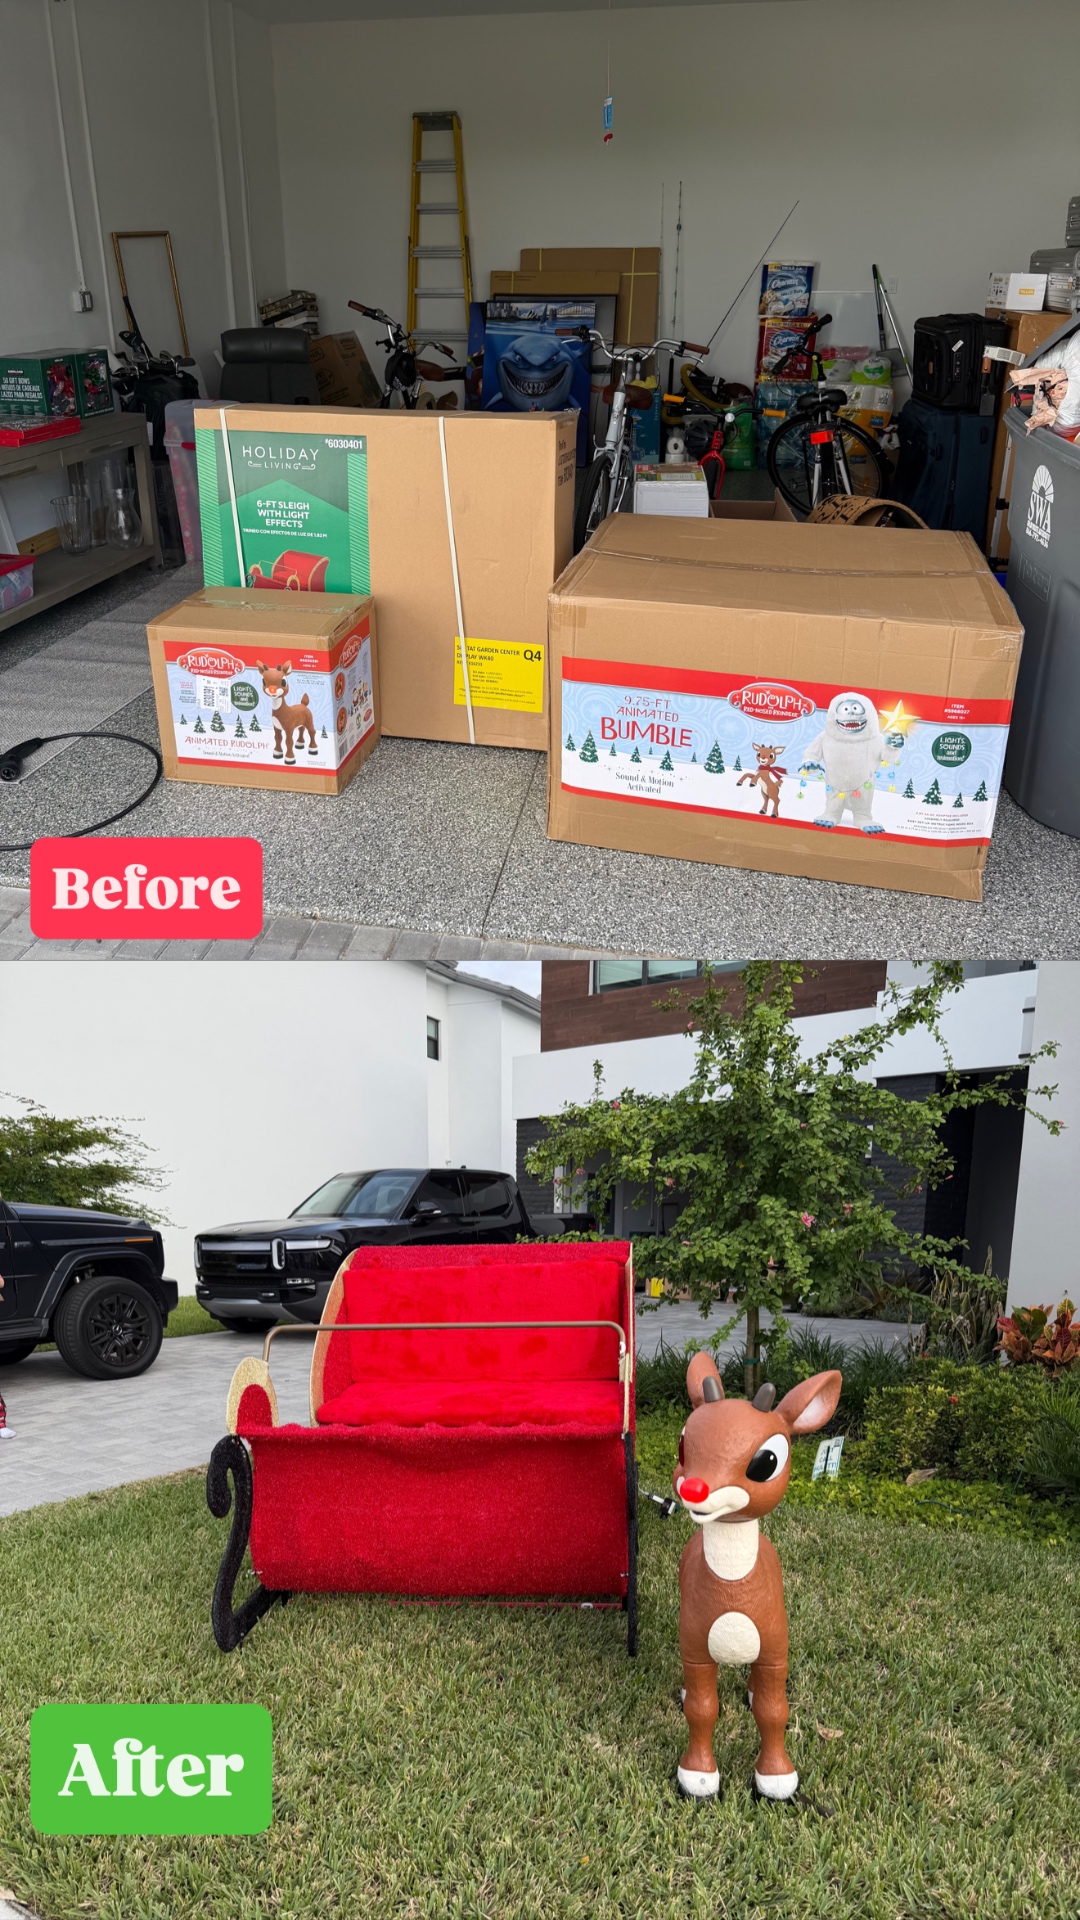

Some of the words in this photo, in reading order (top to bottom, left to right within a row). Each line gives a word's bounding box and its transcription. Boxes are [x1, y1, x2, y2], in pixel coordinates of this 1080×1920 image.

[771, 278, 799, 289] Charmin
[325, 438, 363, 449] #6030401
[242, 445, 319, 461] HOLIDAY
[264, 461, 299, 470] LIVING
[256, 499, 277, 509] 6-FT
[278, 501, 310, 510] SLEIGH
[257, 509, 282, 518] WITH
[283, 510, 310, 519] LIGHT
[1027, 491, 1052, 534] SWA
[265, 519, 303, 528] EFFECTS
[187, 655, 235, 669] RUDOLPH
[523, 649, 542, 662] Q4
[624, 695, 671, 709] 9.75-FT
[742, 690, 802, 710] RUDOLPH
[616, 706, 679, 723] ANIMATED
[743, 706, 772, 715] RED-NOSED
[773, 709, 799, 717] REINDEER
[601, 717, 693, 748] BUMBLE
[185, 736, 229, 747] ANIMATED
[231, 740, 269, 750] RUDOLPH
[936, 754, 965, 762] animation!
[615, 772, 639, 781] Sound
[648, 776, 674, 788] Motion
[627, 782, 661, 794] Activated
